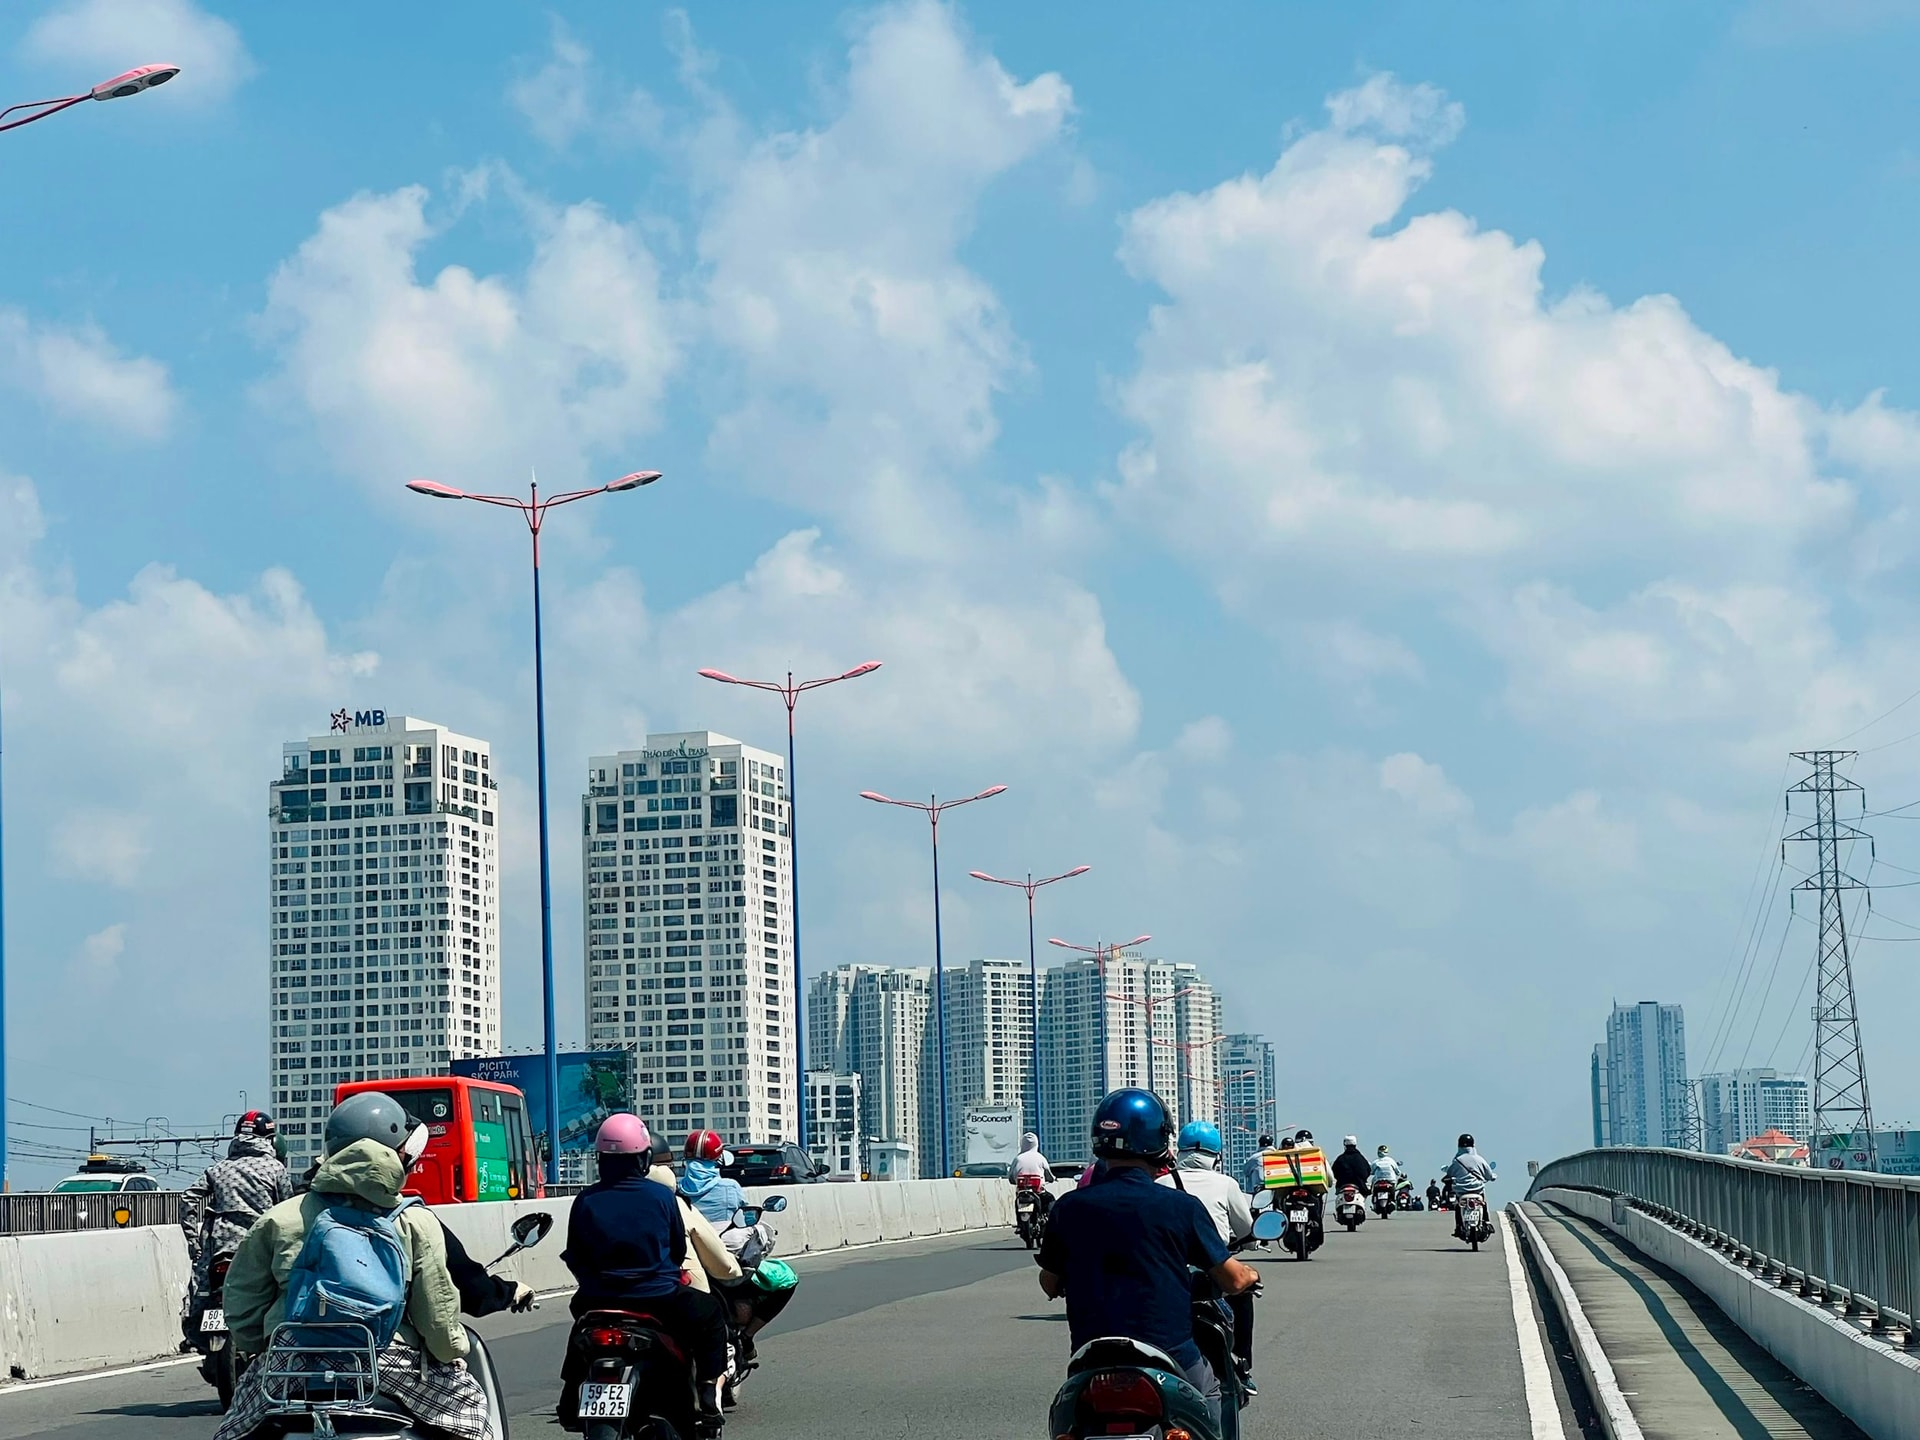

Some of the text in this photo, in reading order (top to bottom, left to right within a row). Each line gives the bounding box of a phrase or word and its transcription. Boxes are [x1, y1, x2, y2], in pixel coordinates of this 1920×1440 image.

[355, 710, 385, 727] MB
[479, 1061, 511, 1071] PICITY
[471, 1070, 520, 1080] SKY PARK
[971, 1115, 1013, 1123] BoConcept
[588, 1385, 624, 1400] 59-E2
[584, 1401, 626, 1416] 198.25
